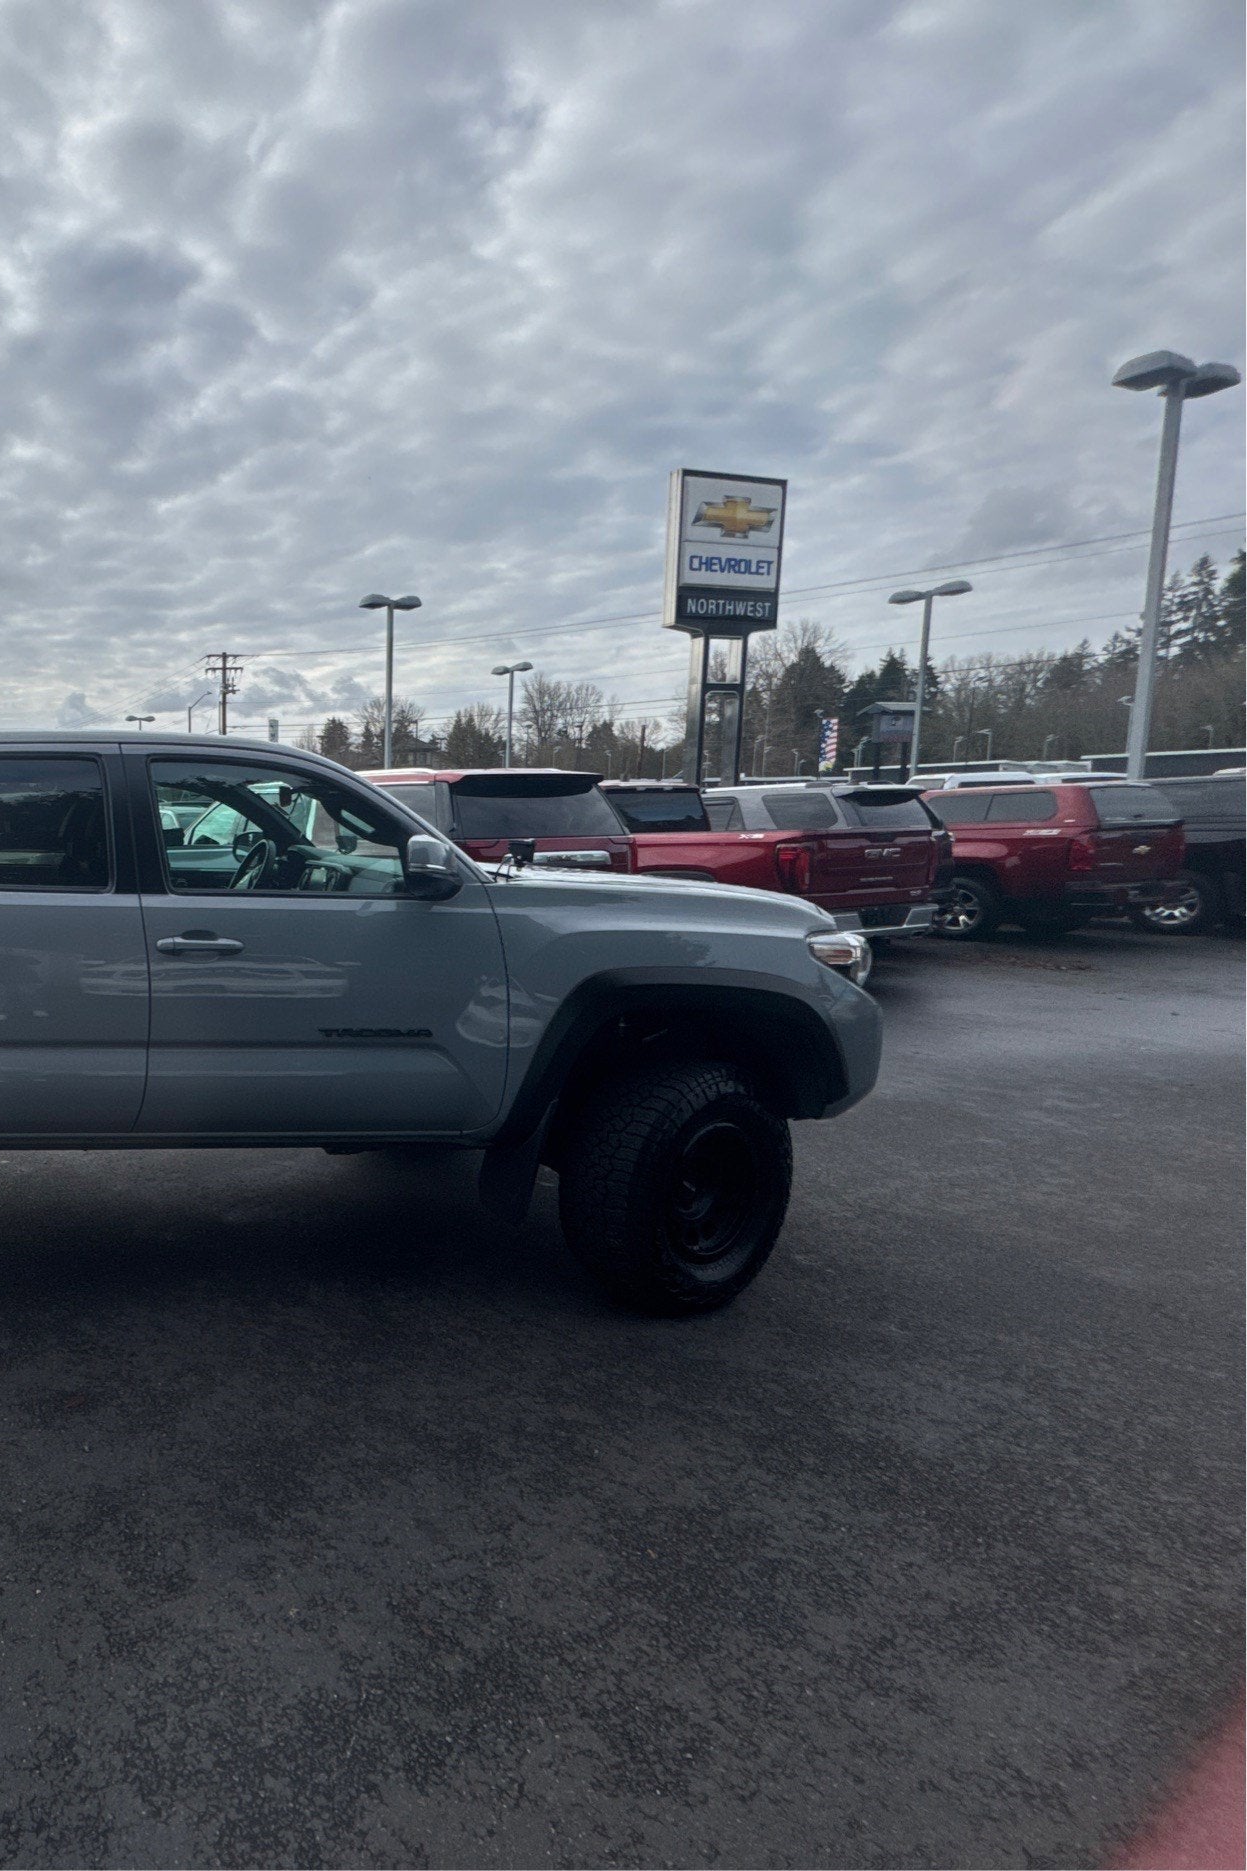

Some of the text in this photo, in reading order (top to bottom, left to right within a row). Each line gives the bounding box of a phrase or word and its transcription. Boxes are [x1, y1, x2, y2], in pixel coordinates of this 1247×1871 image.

[688, 555, 774, 576] CHEVROLET
[686, 598, 771, 618] NORTHWEST
[318, 1028, 433, 1038] TACOMA
